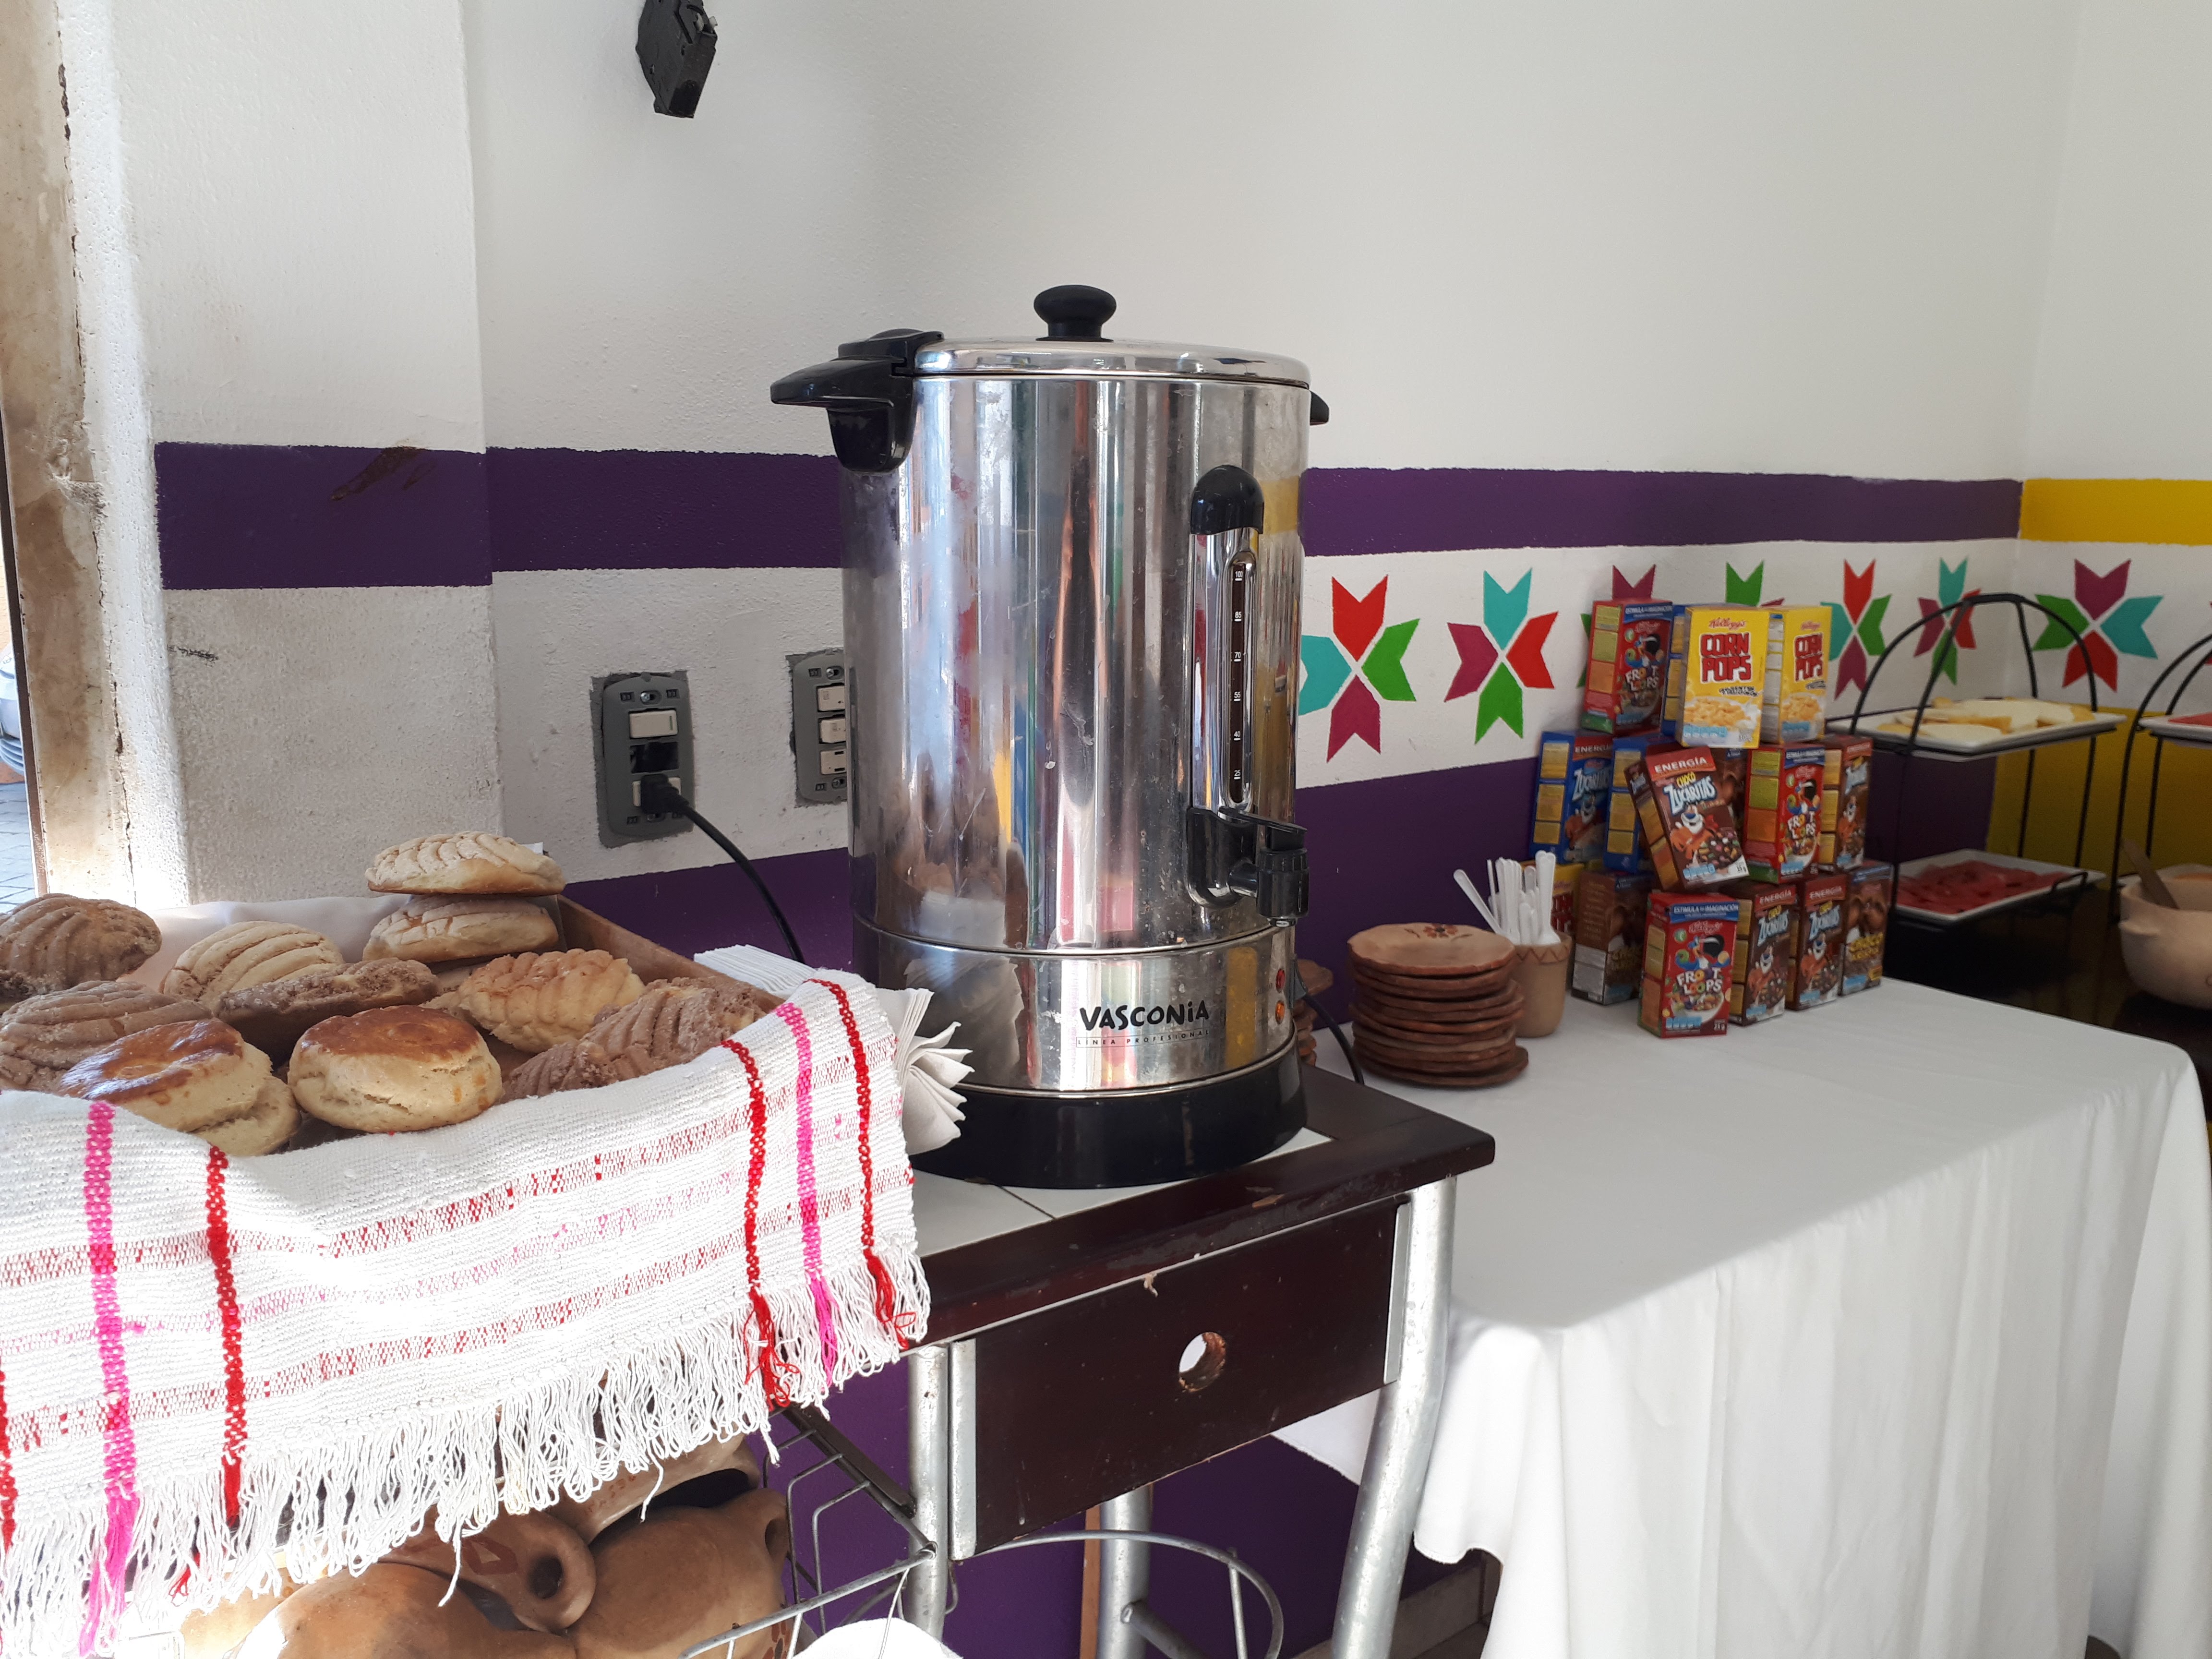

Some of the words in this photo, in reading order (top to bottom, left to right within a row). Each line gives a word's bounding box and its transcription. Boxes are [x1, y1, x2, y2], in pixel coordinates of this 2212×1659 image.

[1700, 633, 1750, 657] CORN
[1701, 655, 1752, 683] POPS
[1654, 757, 1707, 773] ENERGÍA
[1676, 771, 1696, 788] CHOCO
[1663, 775, 1716, 815] ZUCARITAS
[1676, 967, 1722, 986] FROOT
[1683, 979, 1722, 996] LOOPS
[1127, 1030, 1209, 1044] PROFESIONAL
